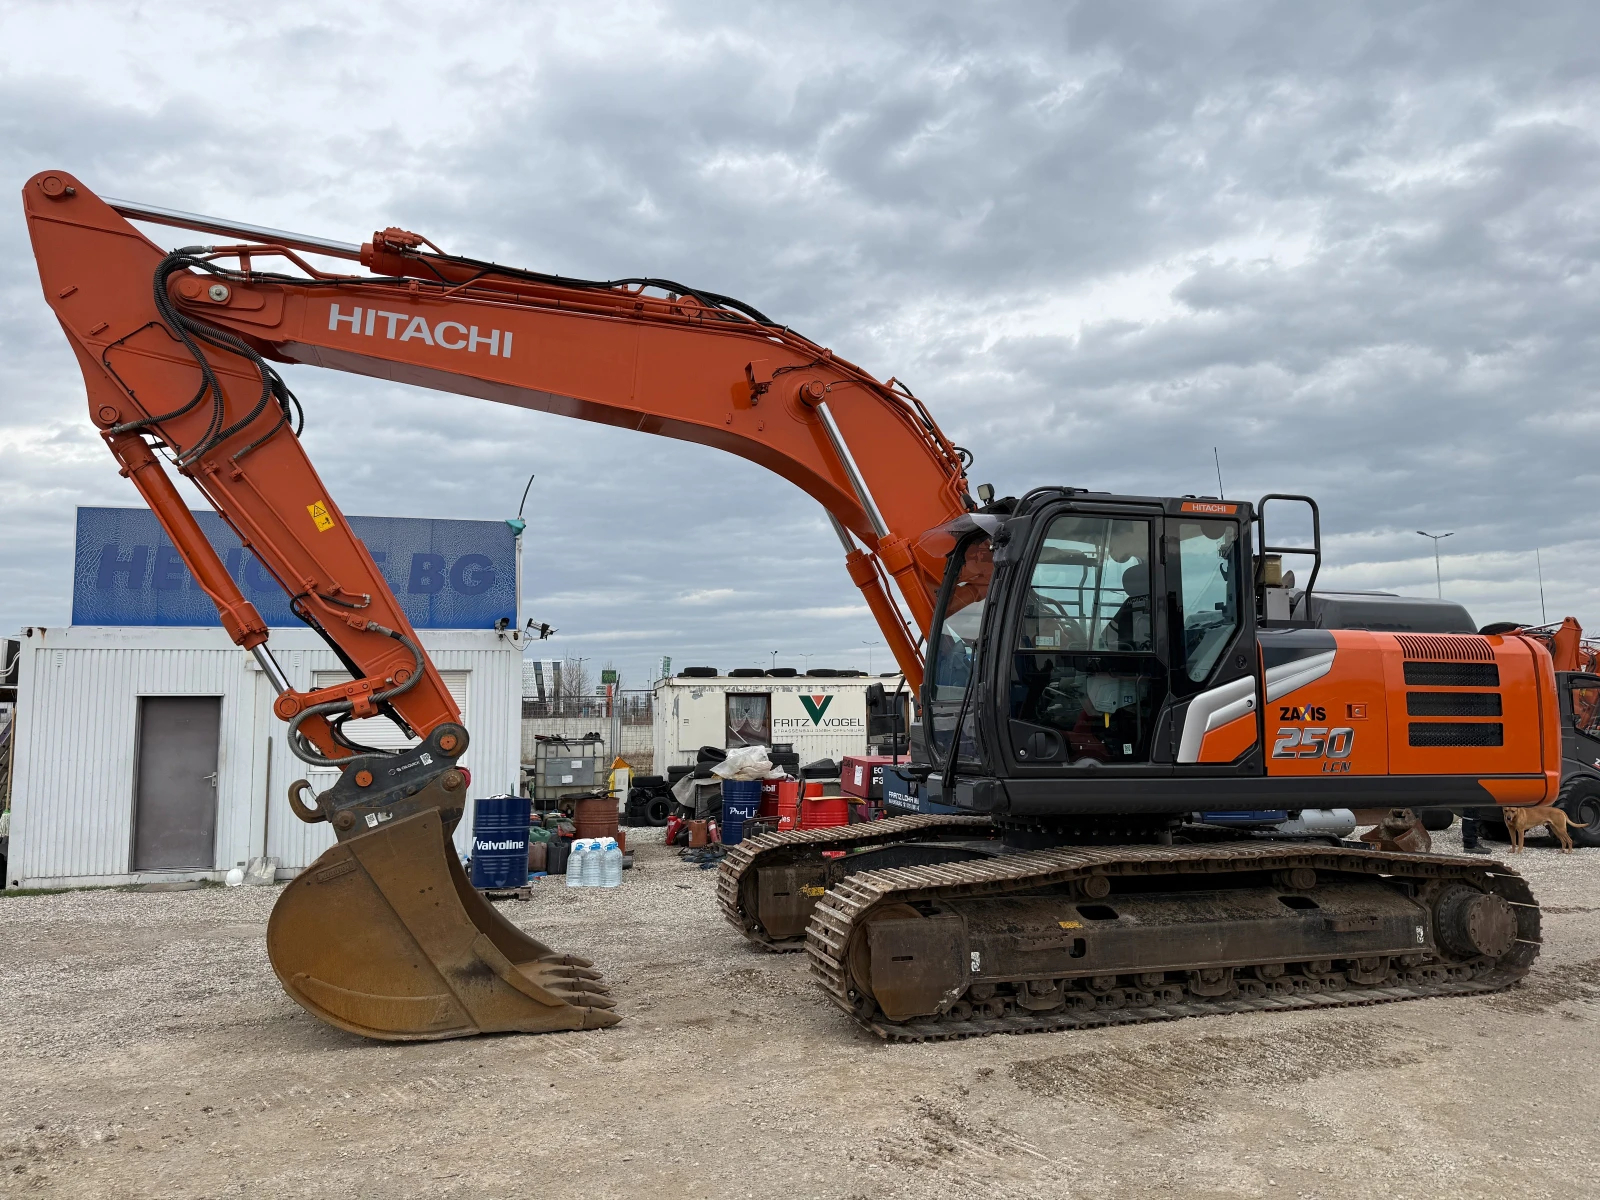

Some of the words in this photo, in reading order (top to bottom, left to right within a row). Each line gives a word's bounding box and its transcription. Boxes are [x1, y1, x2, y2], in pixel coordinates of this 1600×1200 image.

[328, 303, 513, 358] HITACHI
[1192, 503, 1226, 512] HITACHI
[1279, 703, 1327, 722] ZAXIS
[773, 718, 810, 727] FRITZ
[822, 718, 865, 727] VOGEL
[1271, 727, 1355, 759] 250
[1321, 761, 1352, 773] LCN
[761, 784, 777, 792] obil
[476, 840, 525, 851] Valvoline
